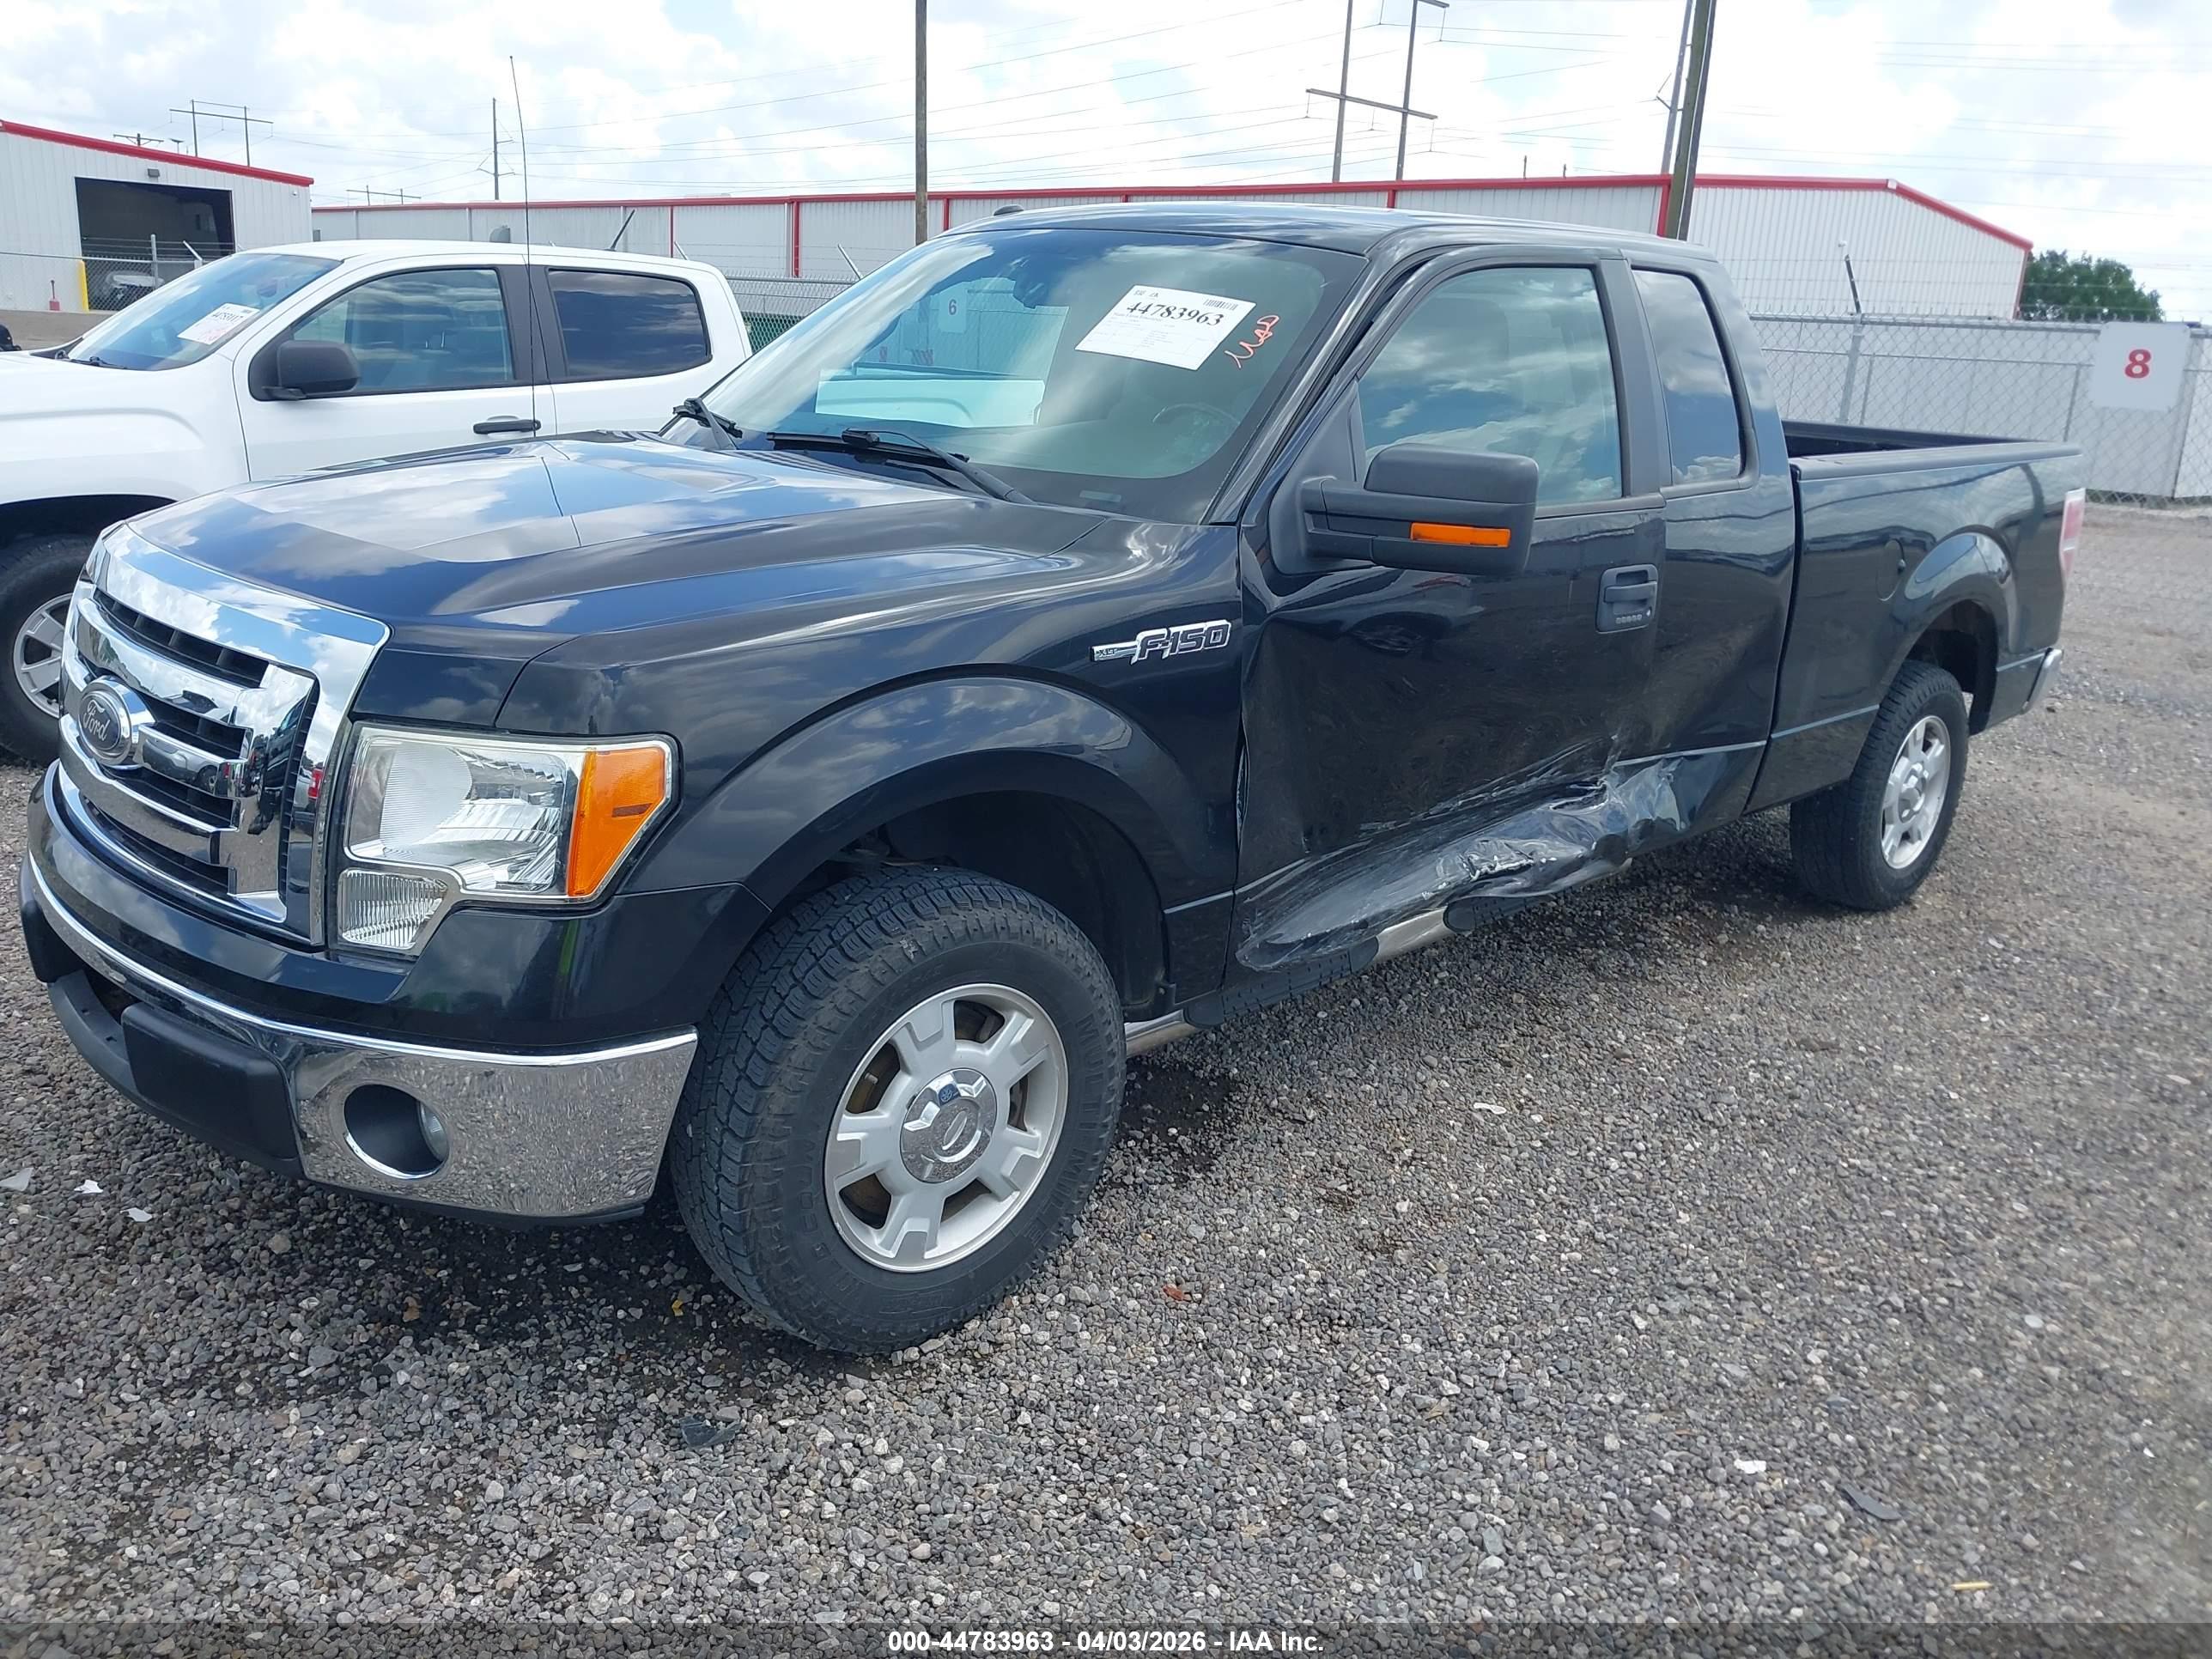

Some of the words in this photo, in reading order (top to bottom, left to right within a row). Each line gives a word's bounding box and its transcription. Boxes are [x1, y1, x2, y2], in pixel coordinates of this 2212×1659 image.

[948, 299, 957, 316] 6
[1127, 301, 1224, 325] 44783963
[2124, 349, 2151, 379] 8
[1130, 619, 1231, 665] F-150
[83, 699, 111, 741] Ford
